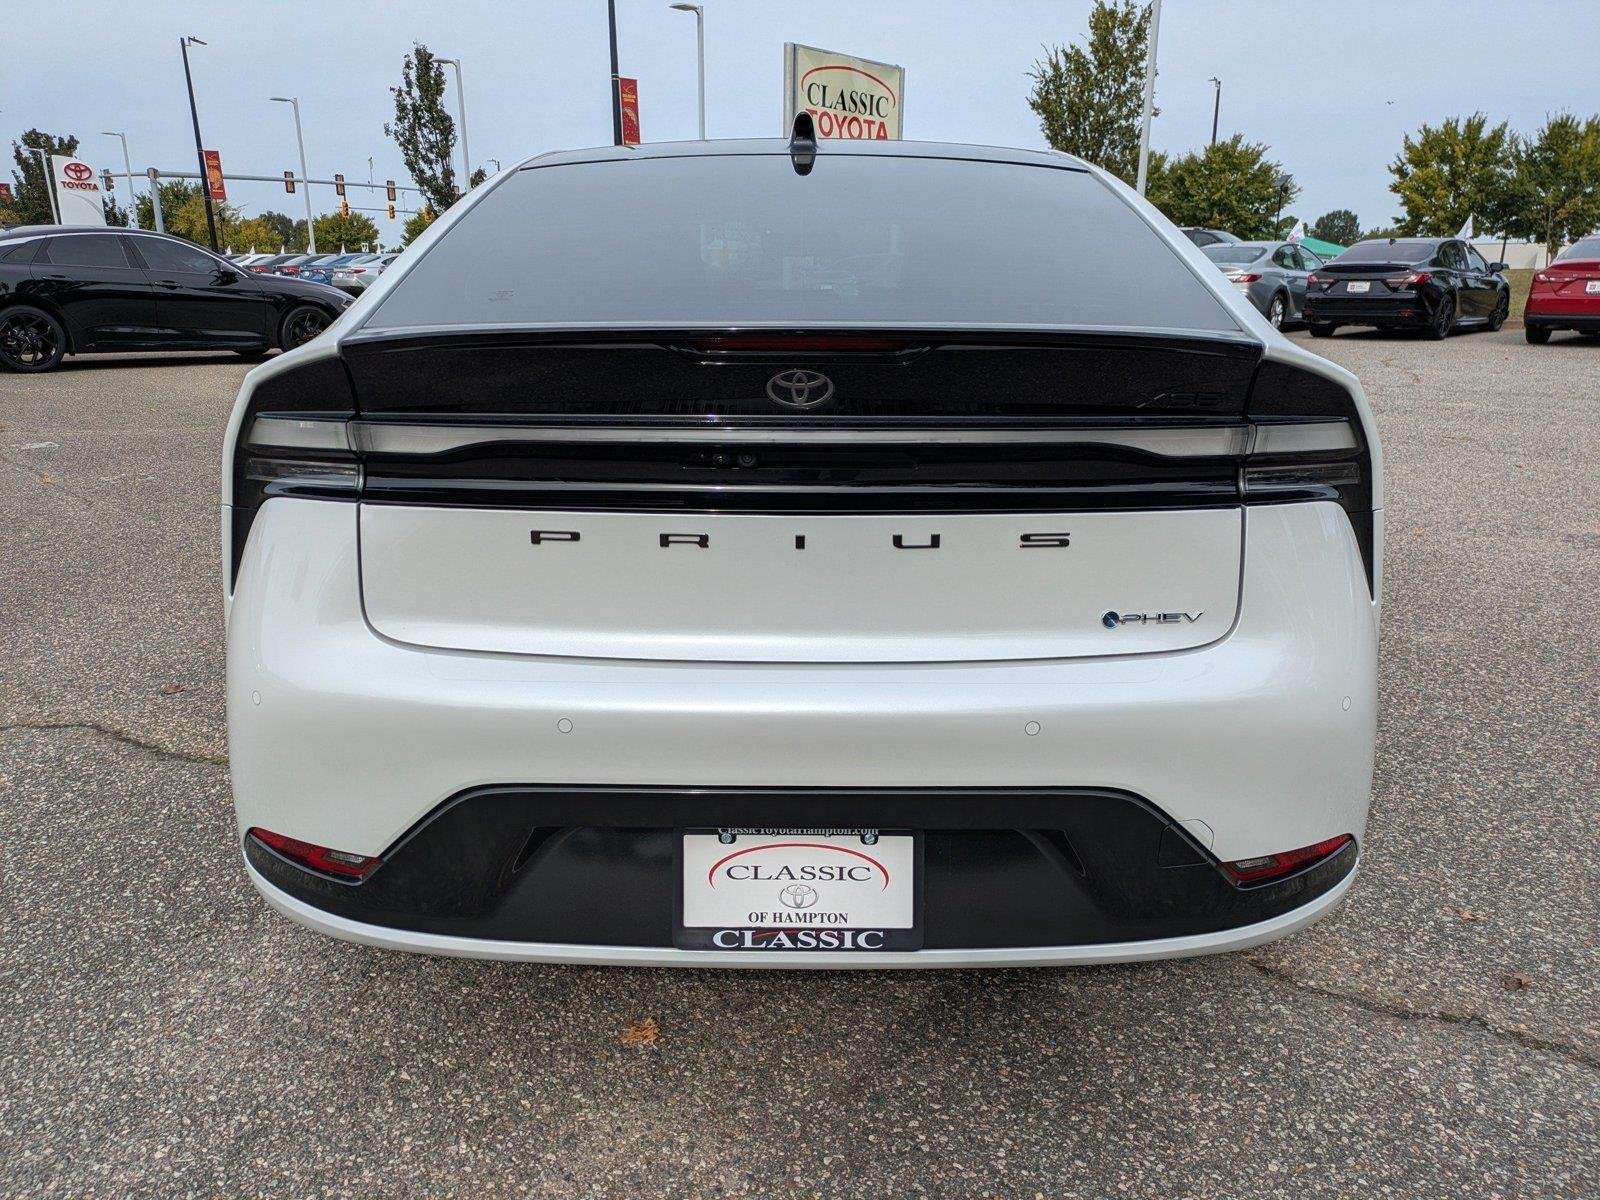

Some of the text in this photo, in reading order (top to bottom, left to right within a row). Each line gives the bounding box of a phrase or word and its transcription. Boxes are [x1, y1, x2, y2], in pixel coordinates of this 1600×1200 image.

[807, 82, 889, 118] CLASSIC
[61, 181, 99, 190] TOYOTA
[530, 530, 1071, 550] PRIUS
[1121, 611, 1204, 624] PHEV
[726, 865, 872, 882] CLASSIC
[748, 911, 849, 924] OF HAMPTON
[713, 930, 884, 949] CLASSIC
